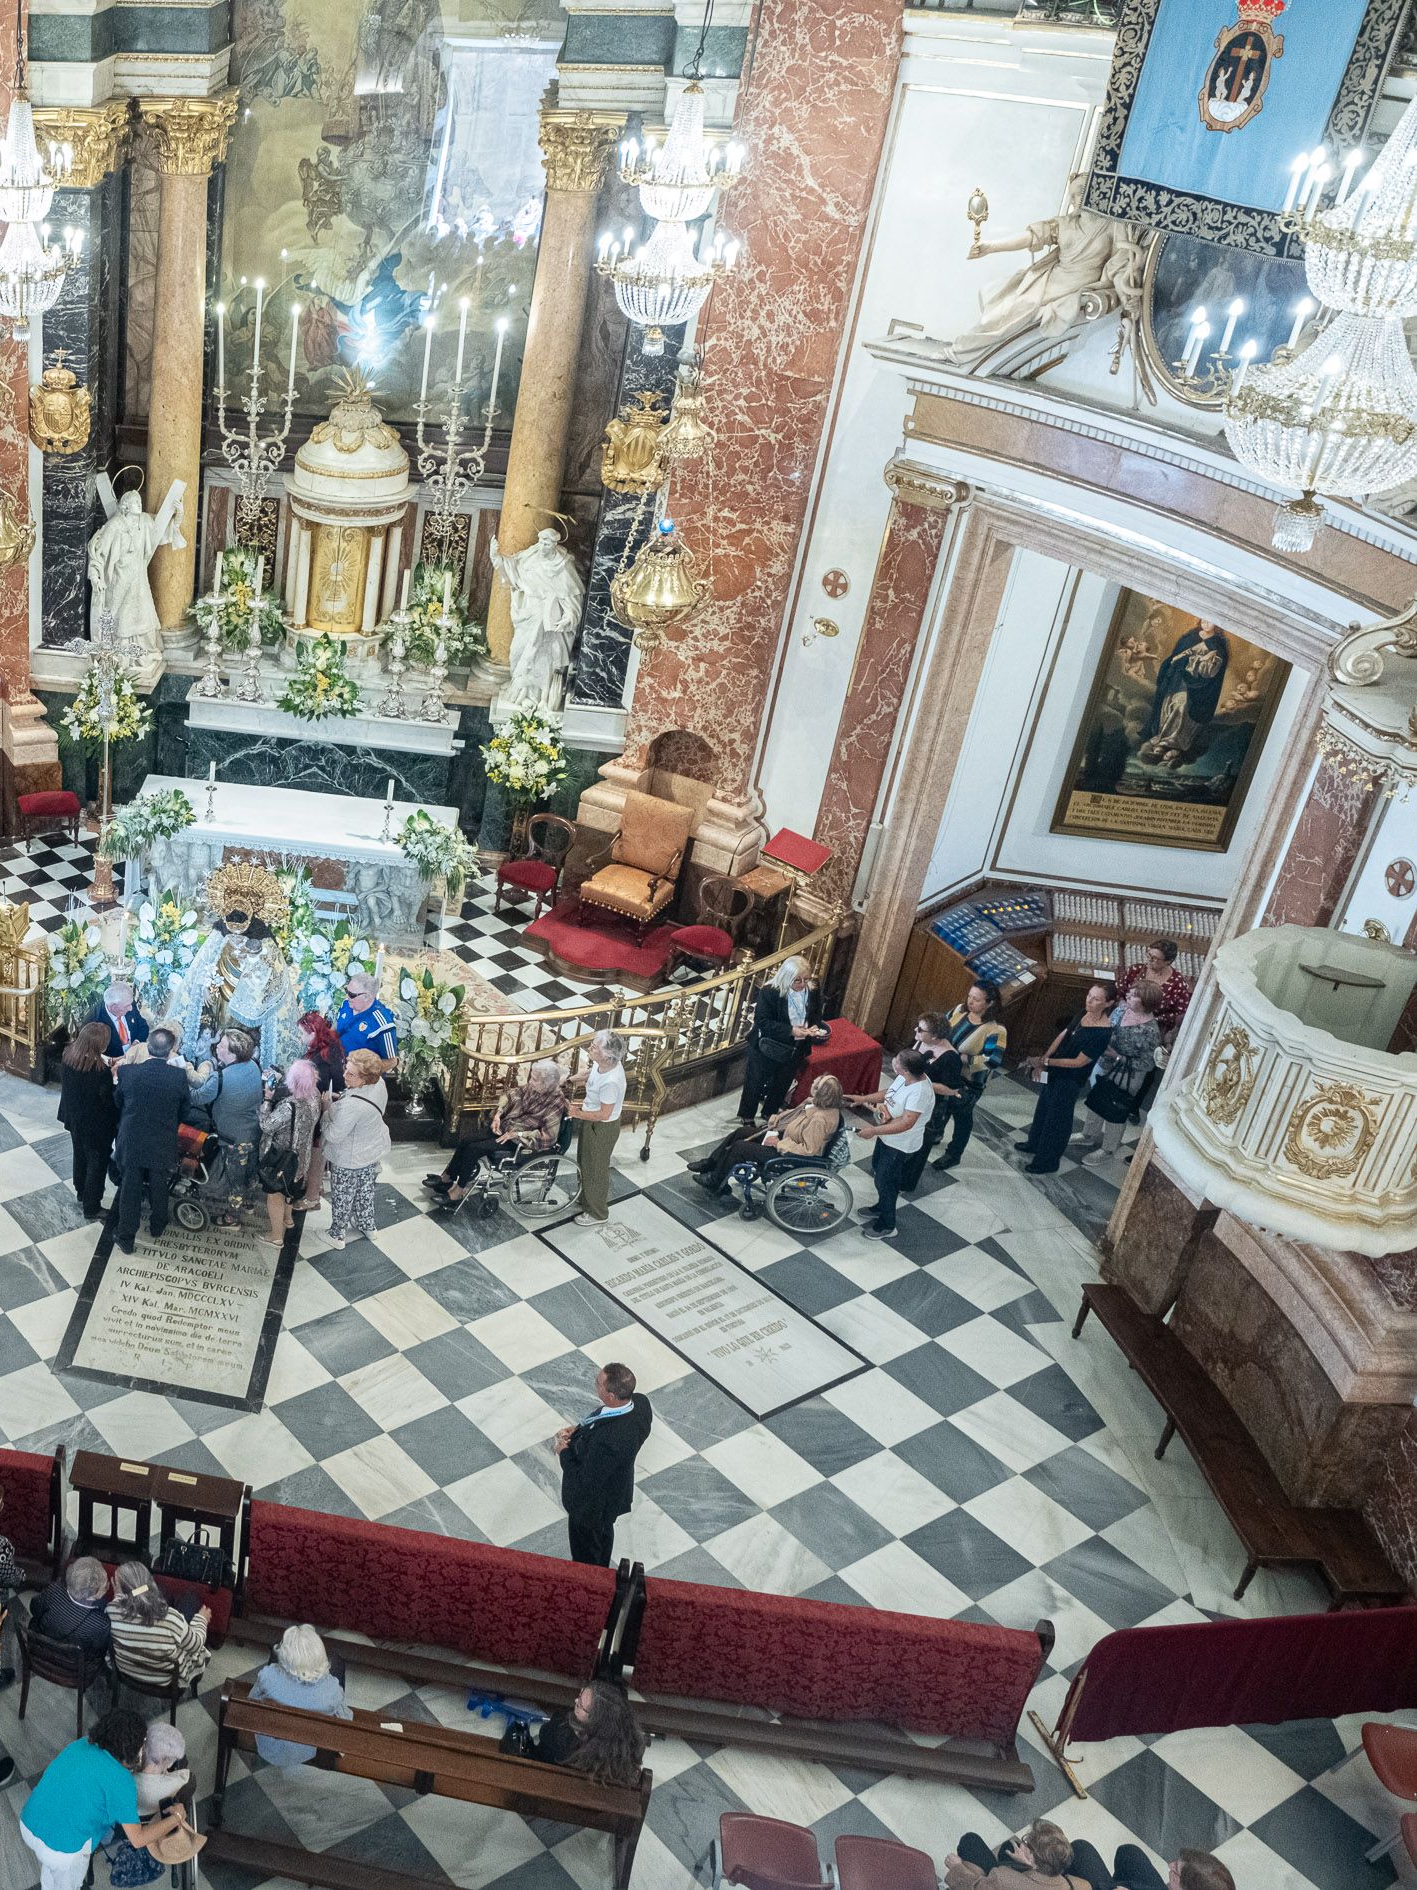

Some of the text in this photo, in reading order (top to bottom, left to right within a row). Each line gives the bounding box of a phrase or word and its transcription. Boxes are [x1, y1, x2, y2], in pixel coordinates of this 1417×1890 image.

[143, 1226, 203, 1241] CDINALIS
[205, 1236, 219, 1245] EX
[152, 1238, 239, 1259] PRESBYTERORVM
[141, 1247, 177, 1260] TITVLO
[180, 1254, 227, 1269] SANCTAE
[230, 1263, 271, 1277] MARIAE
[156, 1261, 224, 1280] DE ARACOELI
[604, 1271, 637, 1288] RICARDO
[651, 1253, 680, 1268] CARLES
[115, 1266, 259, 1297] ARCHIEPISCOPVS BVRGENSIS
[120, 1280, 130, 1288] IV
[155, 1287, 177, 1297] Jan.
[120, 1294, 139, 1303] XIV
[163, 1302, 187, 1312] Mar.
[187, 1306, 238, 1322] MCMXXVI
[110, 1305, 138, 1316] Credo
[139, 1312, 162, 1322] quod
[164, 1315, 214, 1332] Redemptor
[185, 1341, 194, 1349] et
[189, 1331, 202, 1339] die
[204, 1333, 216, 1342] de
[726, 1341, 741, 1351] LO
[735, 1335, 755, 1347] QUE
